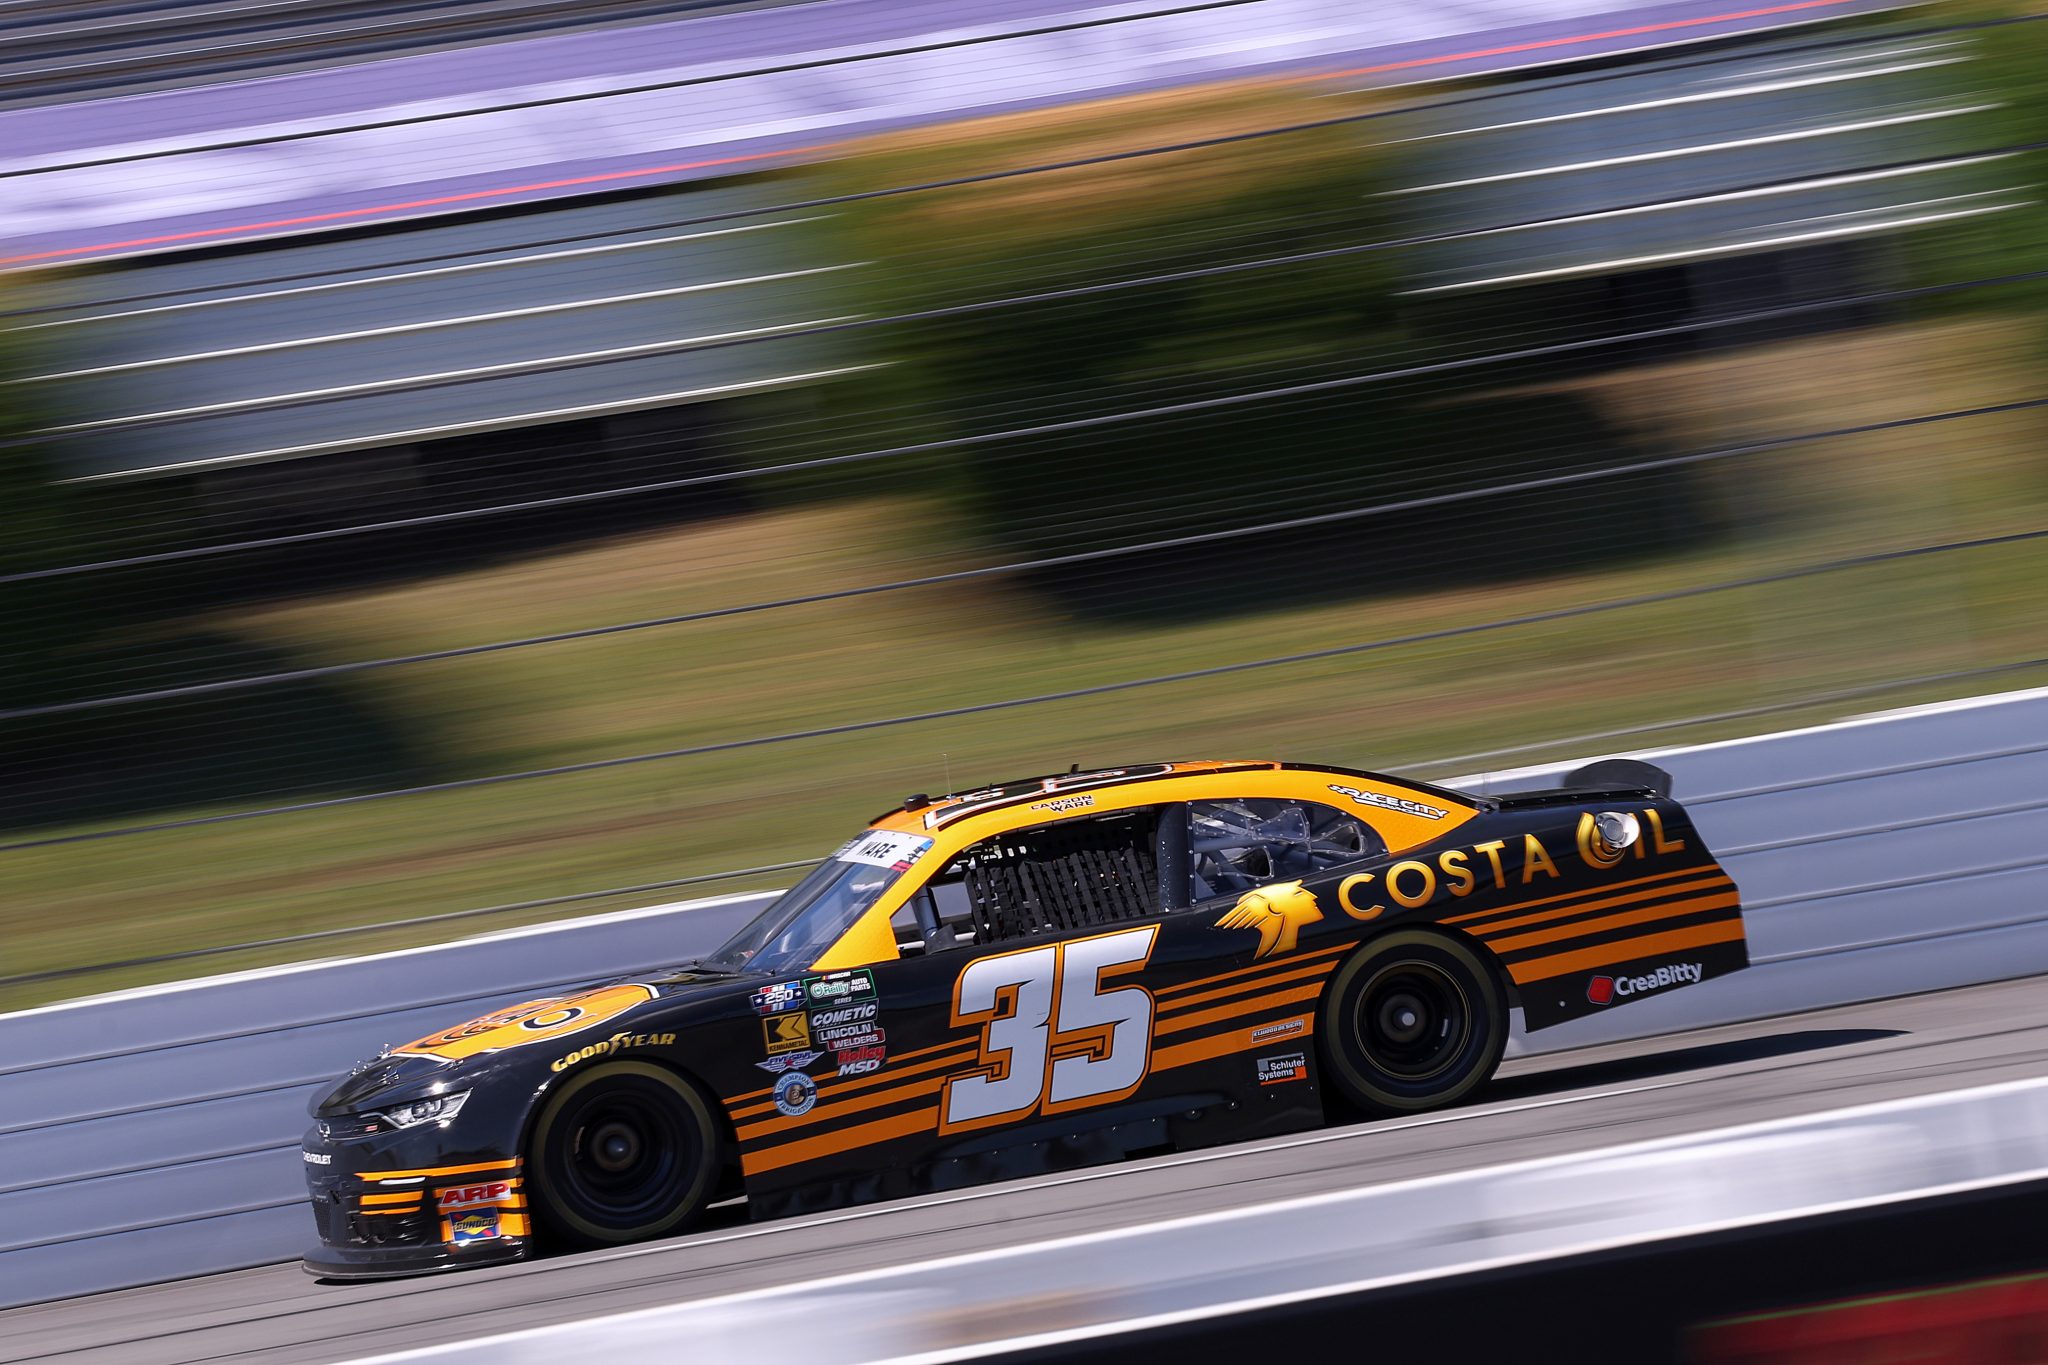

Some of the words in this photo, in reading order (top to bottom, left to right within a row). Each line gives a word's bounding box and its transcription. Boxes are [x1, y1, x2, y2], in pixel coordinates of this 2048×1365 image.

[1031, 794, 1092, 810] CARSON
[1050, 800, 1094, 812] WARE
[857, 841, 898, 859] WARE
[1338, 833, 1560, 921] COSTA
[850, 983, 871, 992] PARTS
[851, 977, 868, 985] AUTO
[1615, 963, 1702, 996] CreaBitty
[764, 989, 794, 1004] 250
[812, 1004, 876, 1026] COMETIC
[820, 1023, 872, 1041] LINCOLN
[940, 925, 1159, 1134] 35
[834, 1033, 879, 1048] WELDERS
[550, 1031, 677, 1072] GOODYEAR
[838, 1046, 886, 1065] Holley
[839, 1060, 880, 1076] MSD
[1270, 1059, 1306, 1071] Schluter
[1258, 1068, 1294, 1081] Systems
[442, 1183, 509, 1204] ARP
[453, 1216, 497, 1232] SUNOCO
